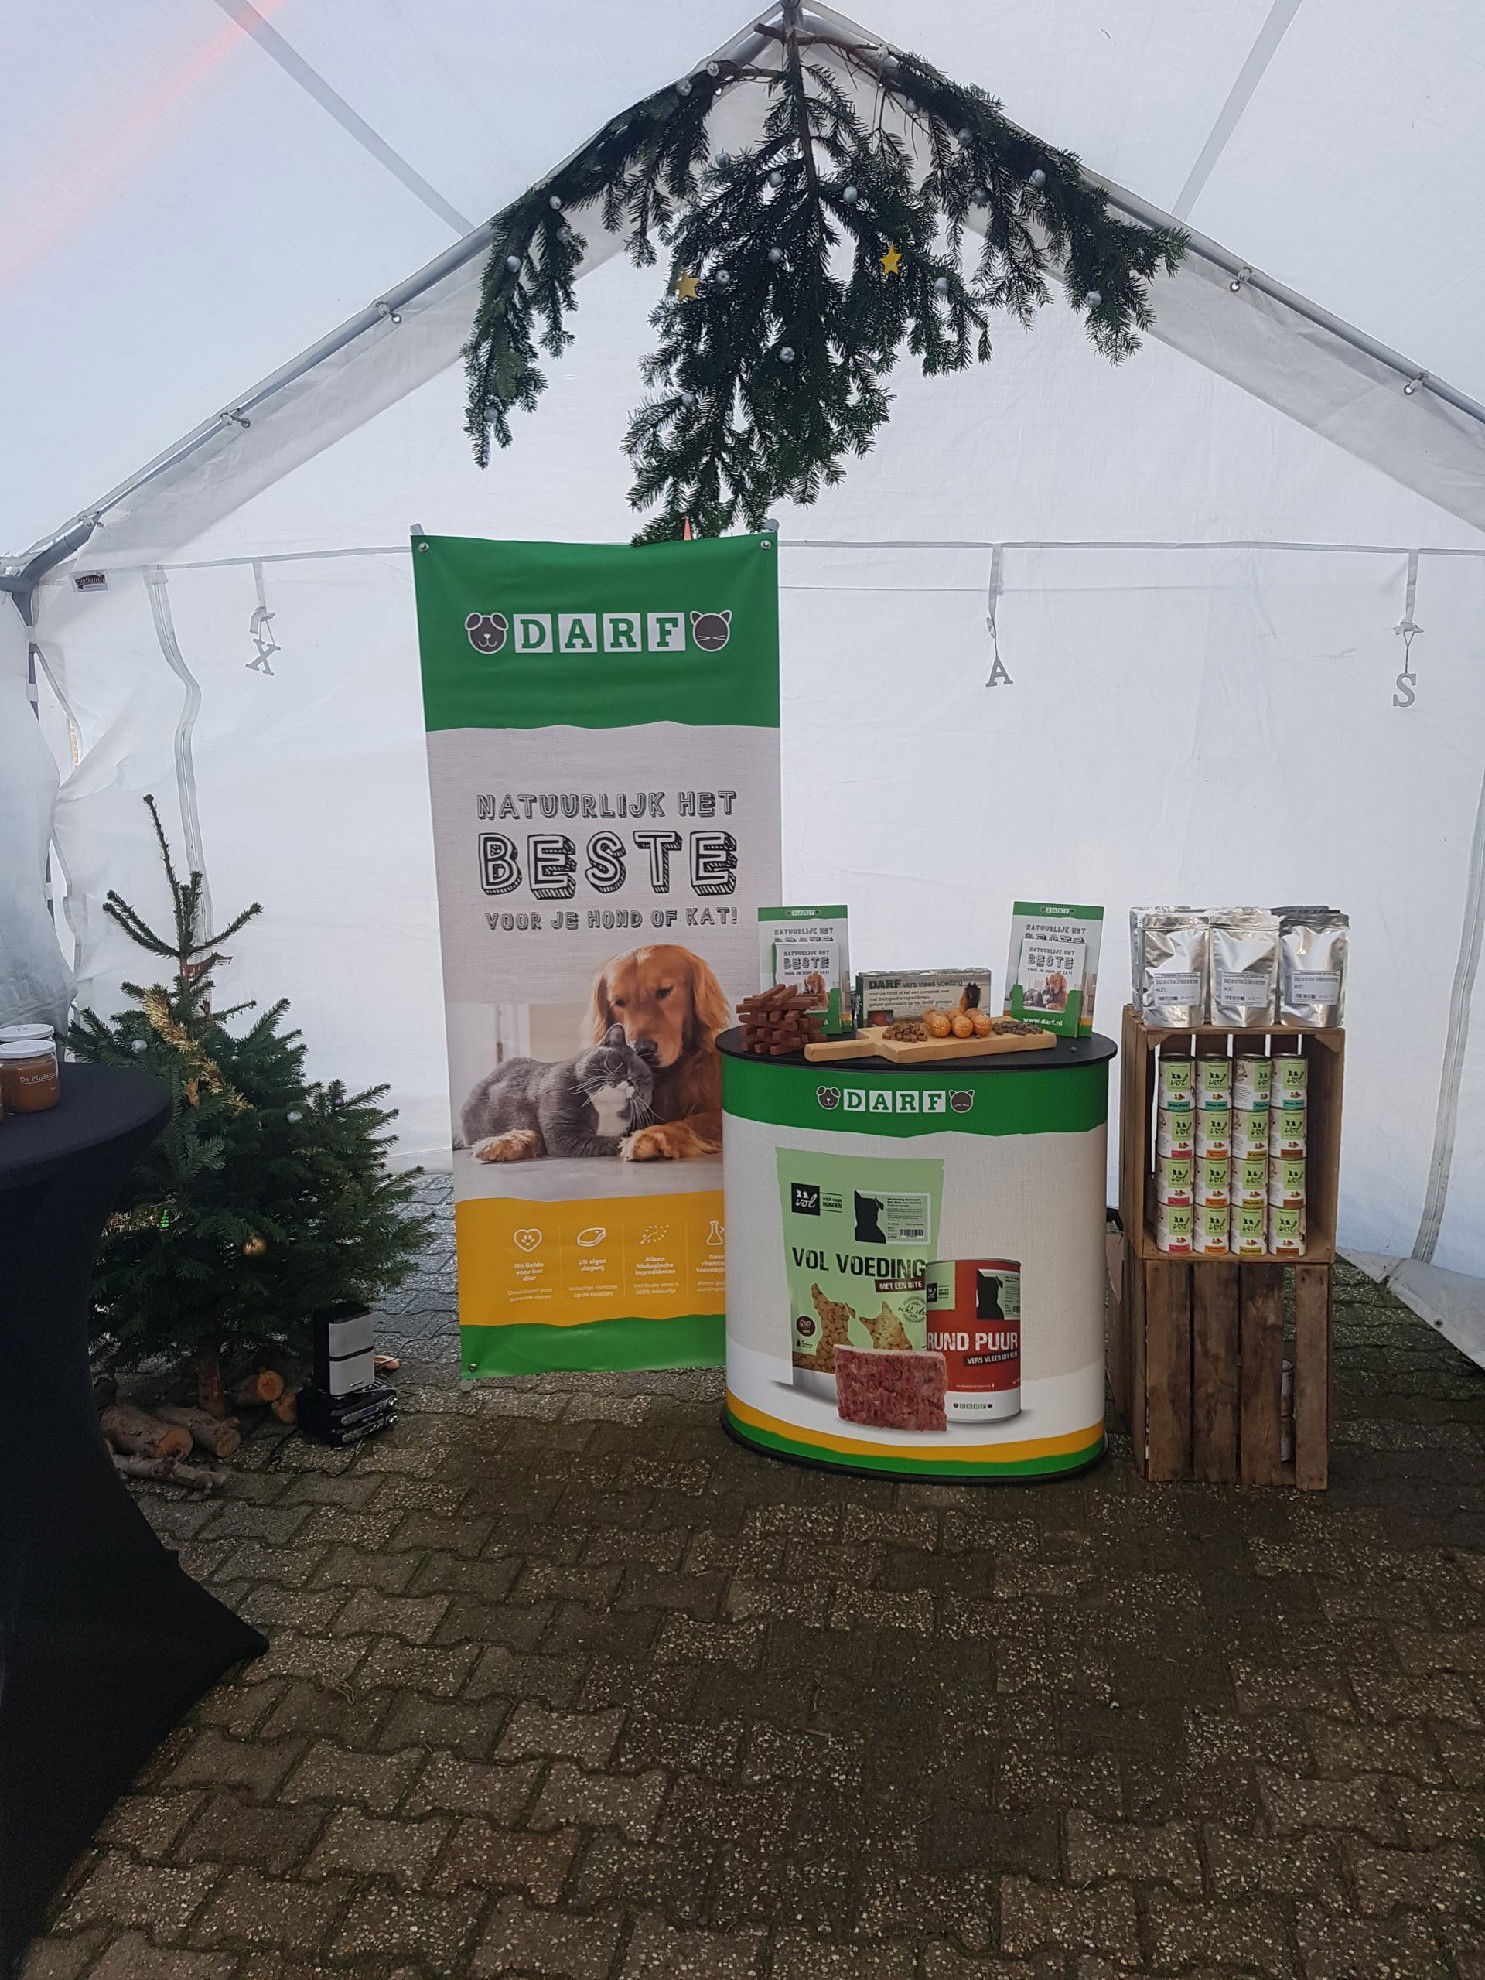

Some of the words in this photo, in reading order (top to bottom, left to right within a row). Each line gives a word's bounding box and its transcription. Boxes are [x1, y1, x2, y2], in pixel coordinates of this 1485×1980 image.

[518, 615, 681, 651] DARF
[246, 638, 282, 676] X
[985, 656, 1013, 687] A
[1393, 673, 1417, 708] S
[476, 791, 665, 821] NATUURLIJK
[677, 790, 737, 817] HET
[477, 830, 739, 900] BESTE
[485, 911, 542, 931] VOOR
[551, 910, 580, 930] JE
[588, 908, 644, 929] HOND
[651, 907, 678, 927] OF
[686, 906, 739, 925] KAT!
[783, 957, 830, 970] BESTE
[1028, 954, 1075, 970] BESTE
[869, 980, 901, 989] DARF
[845, 1091, 944, 1112] DARF
[792, 1247, 829, 1271] VOL
[835, 1253, 926, 1279] VOEDING
[879, 1282, 893, 1291] MET
[894, 1282, 907, 1290] EEN
[908, 1280, 923, 1289] BITE
[927, 1332, 969, 1351] RUND
[974, 1332, 1018, 1351] PUUR
[967, 1356, 983, 1365] VERS
